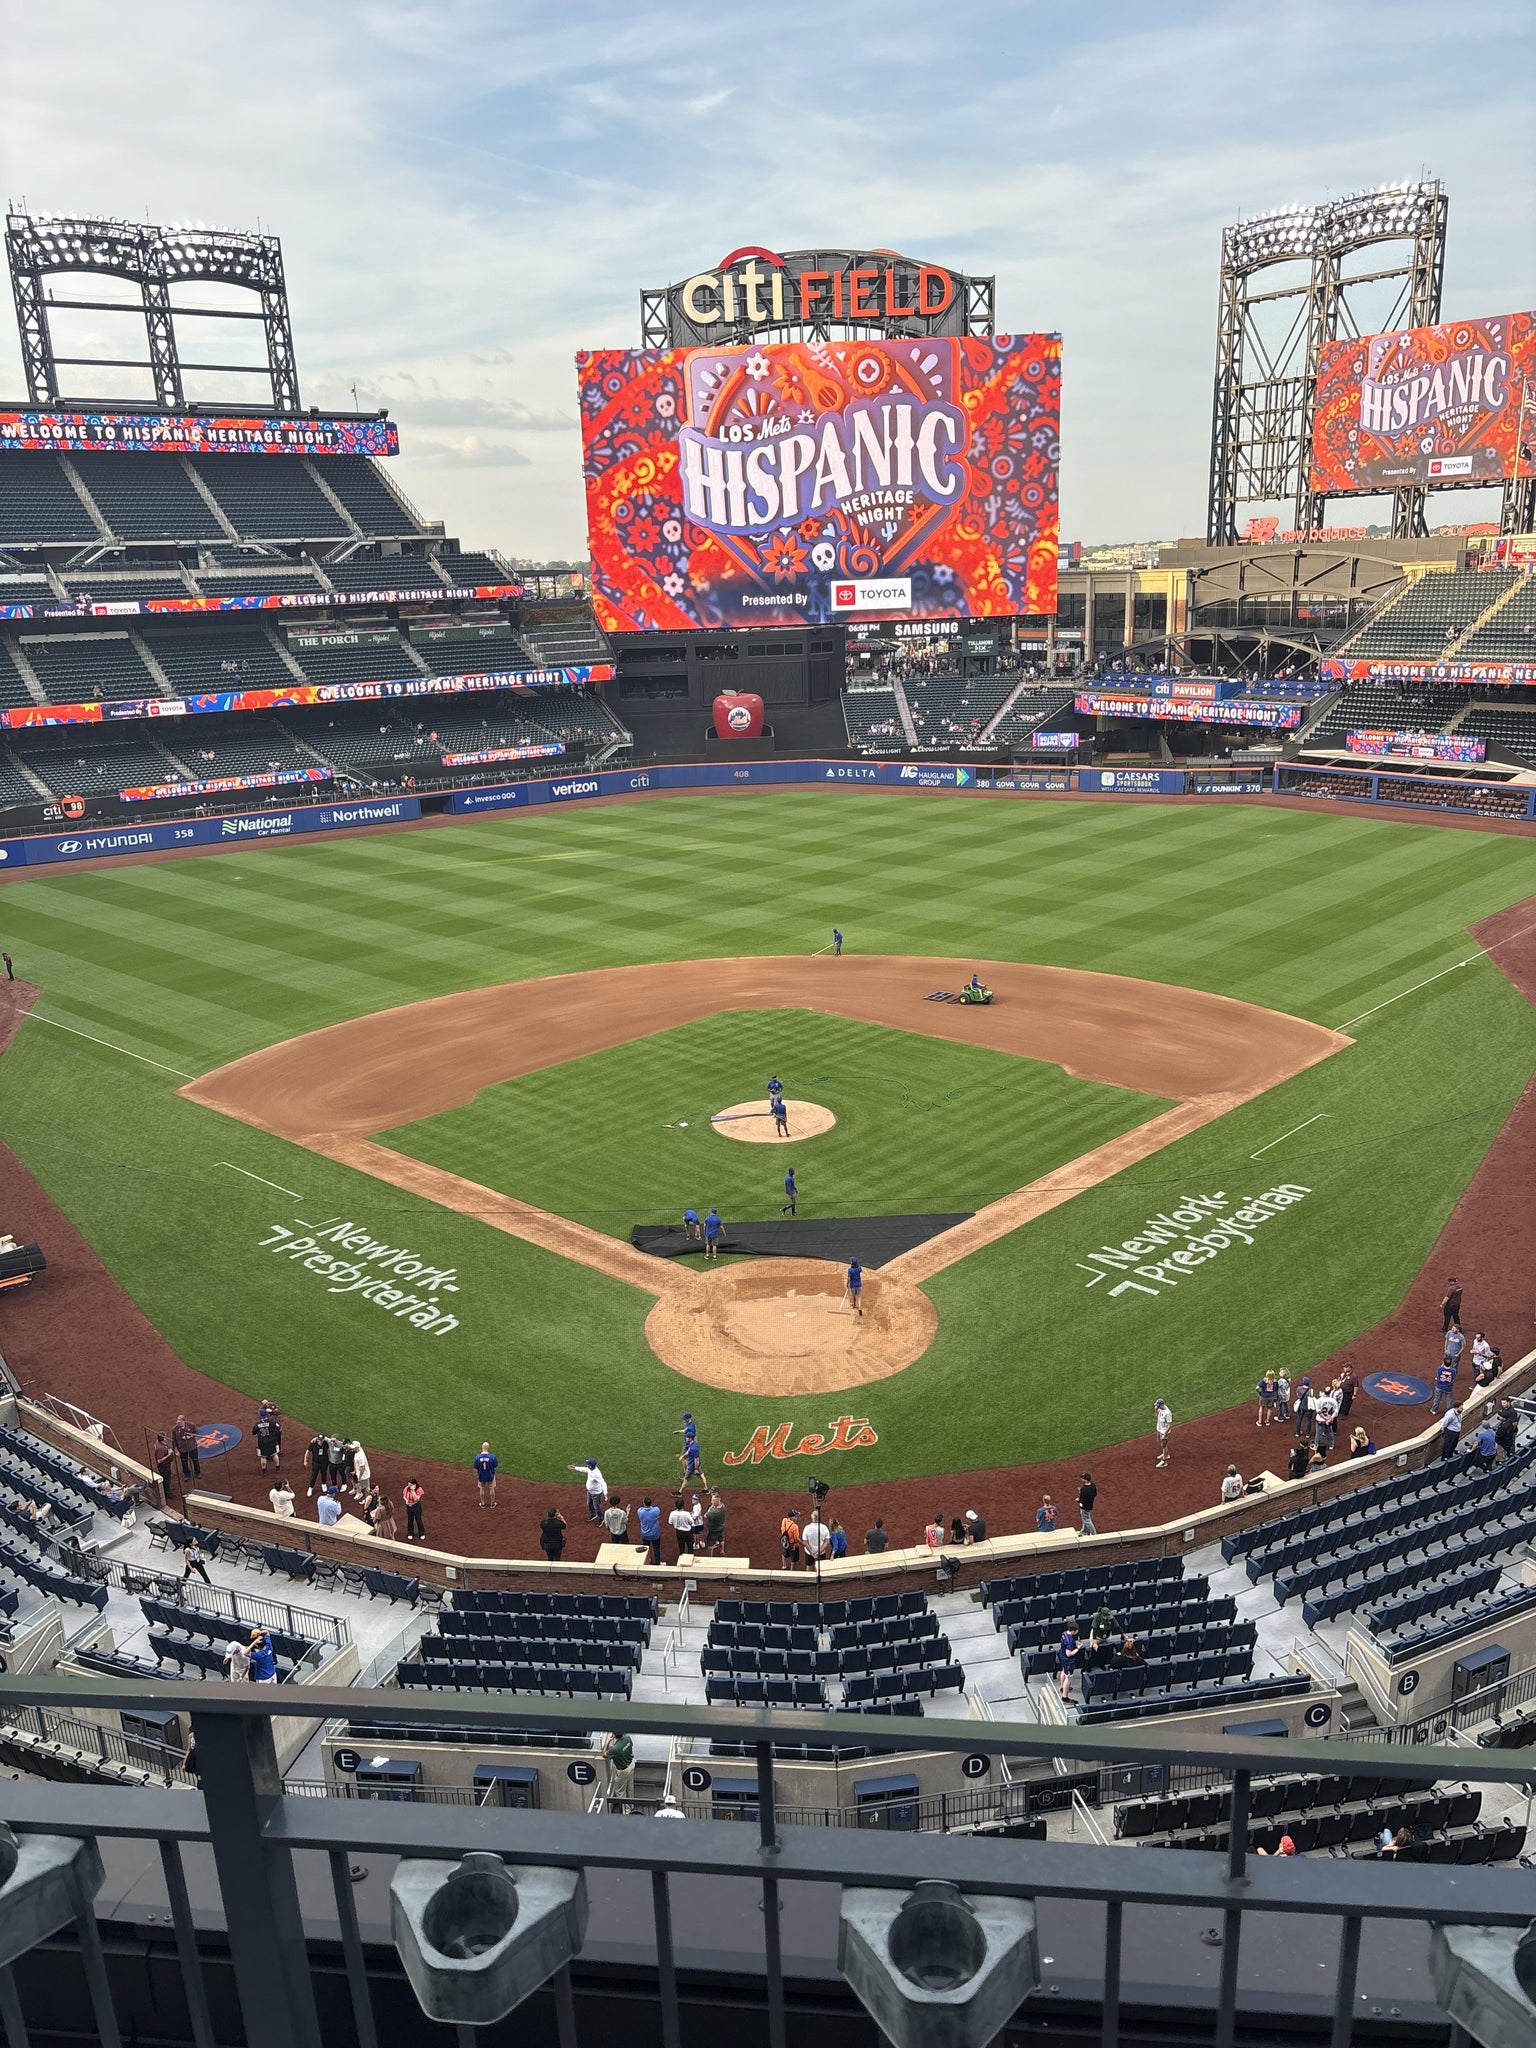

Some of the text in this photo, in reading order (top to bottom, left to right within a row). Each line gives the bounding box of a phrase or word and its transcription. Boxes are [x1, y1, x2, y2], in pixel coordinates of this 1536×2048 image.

[682, 257, 953, 324] citi FIELD
[1382, 366, 1419, 386] LOS Mets
[1362, 354, 1506, 432] HISPANIC
[1439, 404, 1479, 422] HERITAGE
[720, 414, 792, 443] LOS Mets
[1447, 414, 1473, 428] NIGHT
[2, 424, 333, 444] WELCOME TO HISPANIC HERITAGE NIGHT
[684, 403, 956, 527] HISPANIC
[1382, 467, 1417, 476] Presented By
[1444, 462, 1470, 470] TOYOTA
[841, 490, 914, 515] HERITAGE
[857, 506, 904, 526] NIGHT
[1280, 525, 1367, 542] new balance
[281, 588, 475, 606] WELCOME TO HISPANIC HERITAGE NIGHT
[742, 592, 808, 608] Presented By
[859, 588, 906, 601] TOYOTA
[44, 608, 85, 617] Presented By
[848, 623, 880, 632] 06:08 PM
[895, 621, 959, 636] SAMSUNG
[298, 635, 359, 647] THE PORCH
[1370, 664, 1426, 677] WELCOME
[1431, 666, 1446, 677] TO
[1451, 667, 1510, 679] HISPANIC
[320, 671, 560, 700] WELCOME TO HISPANIC HERITAGE NIGHT
[1155, 683, 1213, 696] citi PAVILION
[1092, 700, 1277, 721] WELCOME TO HISPANIC HERITAGE NIGHT
[1358, 734, 1385, 742] WELCOME
[1394, 736, 1421, 744] HISPANIC
[1424, 738, 1453, 746] HERITAGE
[1454, 740, 1473, 748] NIGHT
[630, 773, 649, 788] citi
[734, 769, 750, 778] 408
[838, 768, 876, 778] DELTA
[919, 772, 954, 780] HAUGLAND
[1116, 772, 1160, 782] CAESARS
[155, 773, 299, 796] WELCOME TO HISPANIC HERITAGE NIGHT
[552, 780, 598, 797] verizon
[977, 780, 1064, 790] 380 GOYA GOYA GOYA
[1246, 784, 1260, 793] 370
[475, 791, 516, 804] invesco QQQ
[1301, 791, 1337, 799] CADILLAC
[43, 804, 61, 816] citi
[71, 801, 83, 811] 98
[333, 804, 400, 823] Northwell
[1478, 810, 1521, 819] CADILLAC
[238, 814, 292, 832] National
[174, 828, 194, 839] 358
[257, 826, 290, 836] Car Rental
[87, 832, 152, 850] HYUNDAI
[1133, 1183, 1312, 1285] Presbyterian
[272, 1236, 460, 1336] Presbyterian
[723, 1415, 878, 1466] Mets
[1403, 1675, 1414, 1691] B
[1310, 1707, 1325, 1723] C
[341, 1753, 355, 1769] E
[969, 1758, 983, 1774] D
[574, 1765, 588, 1780] E
[689, 1771, 704, 1786] D
